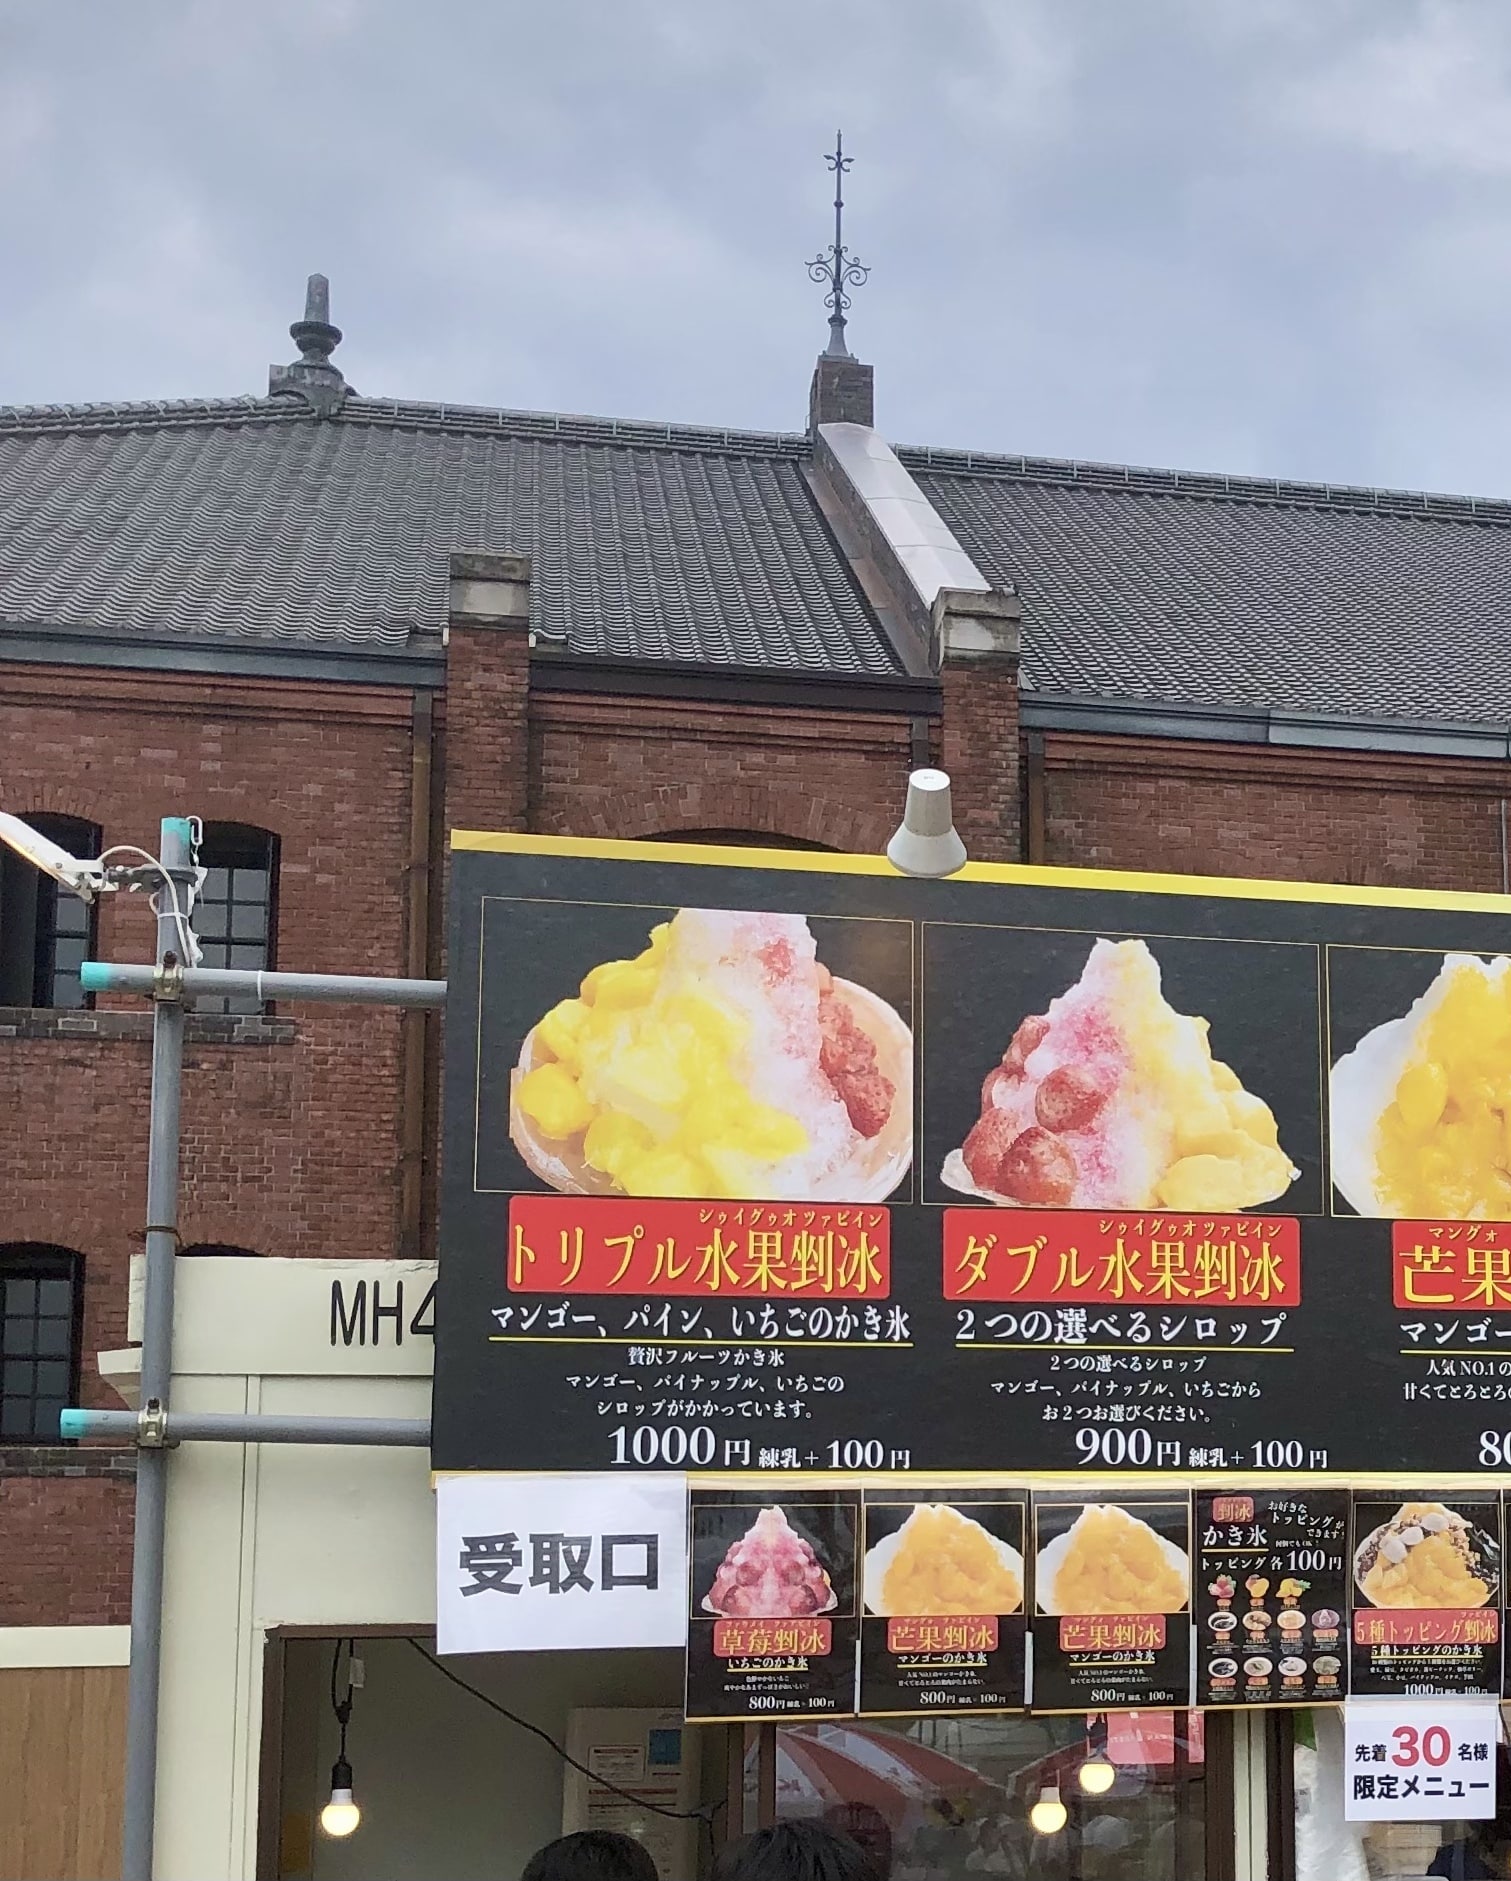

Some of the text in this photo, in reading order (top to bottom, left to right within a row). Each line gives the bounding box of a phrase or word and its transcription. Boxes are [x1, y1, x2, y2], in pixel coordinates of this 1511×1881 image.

[490, 1301, 911, 1343] マンゴー、パイン、いちごのかき氷
[956, 1307, 1288, 1346] 2つの選べるシロップ
[628, 1347, 785, 1368] 贅沢フルーツかき氷
[1050, 1353, 1208, 1374] 2つの選べるシロップ
[565, 1374, 845, 1394] マンゴー、パイナップル、いちごの
[990, 1379, 1263, 1399] マンゴー、パイナップル、いちごから
[597, 1398, 816, 1421] シロップがかかっています。
[607, 1426, 751, 1467] 1000円
[1075, 1427, 1182, 1467] 900円
[1202, 1524, 1268, 1547] かき氷
[458, 1531, 659, 1597] 受取口
[1354, 1725, 1489, 1768] 先着30名様
[1353, 1773, 1490, 1801] 限定メニュー
